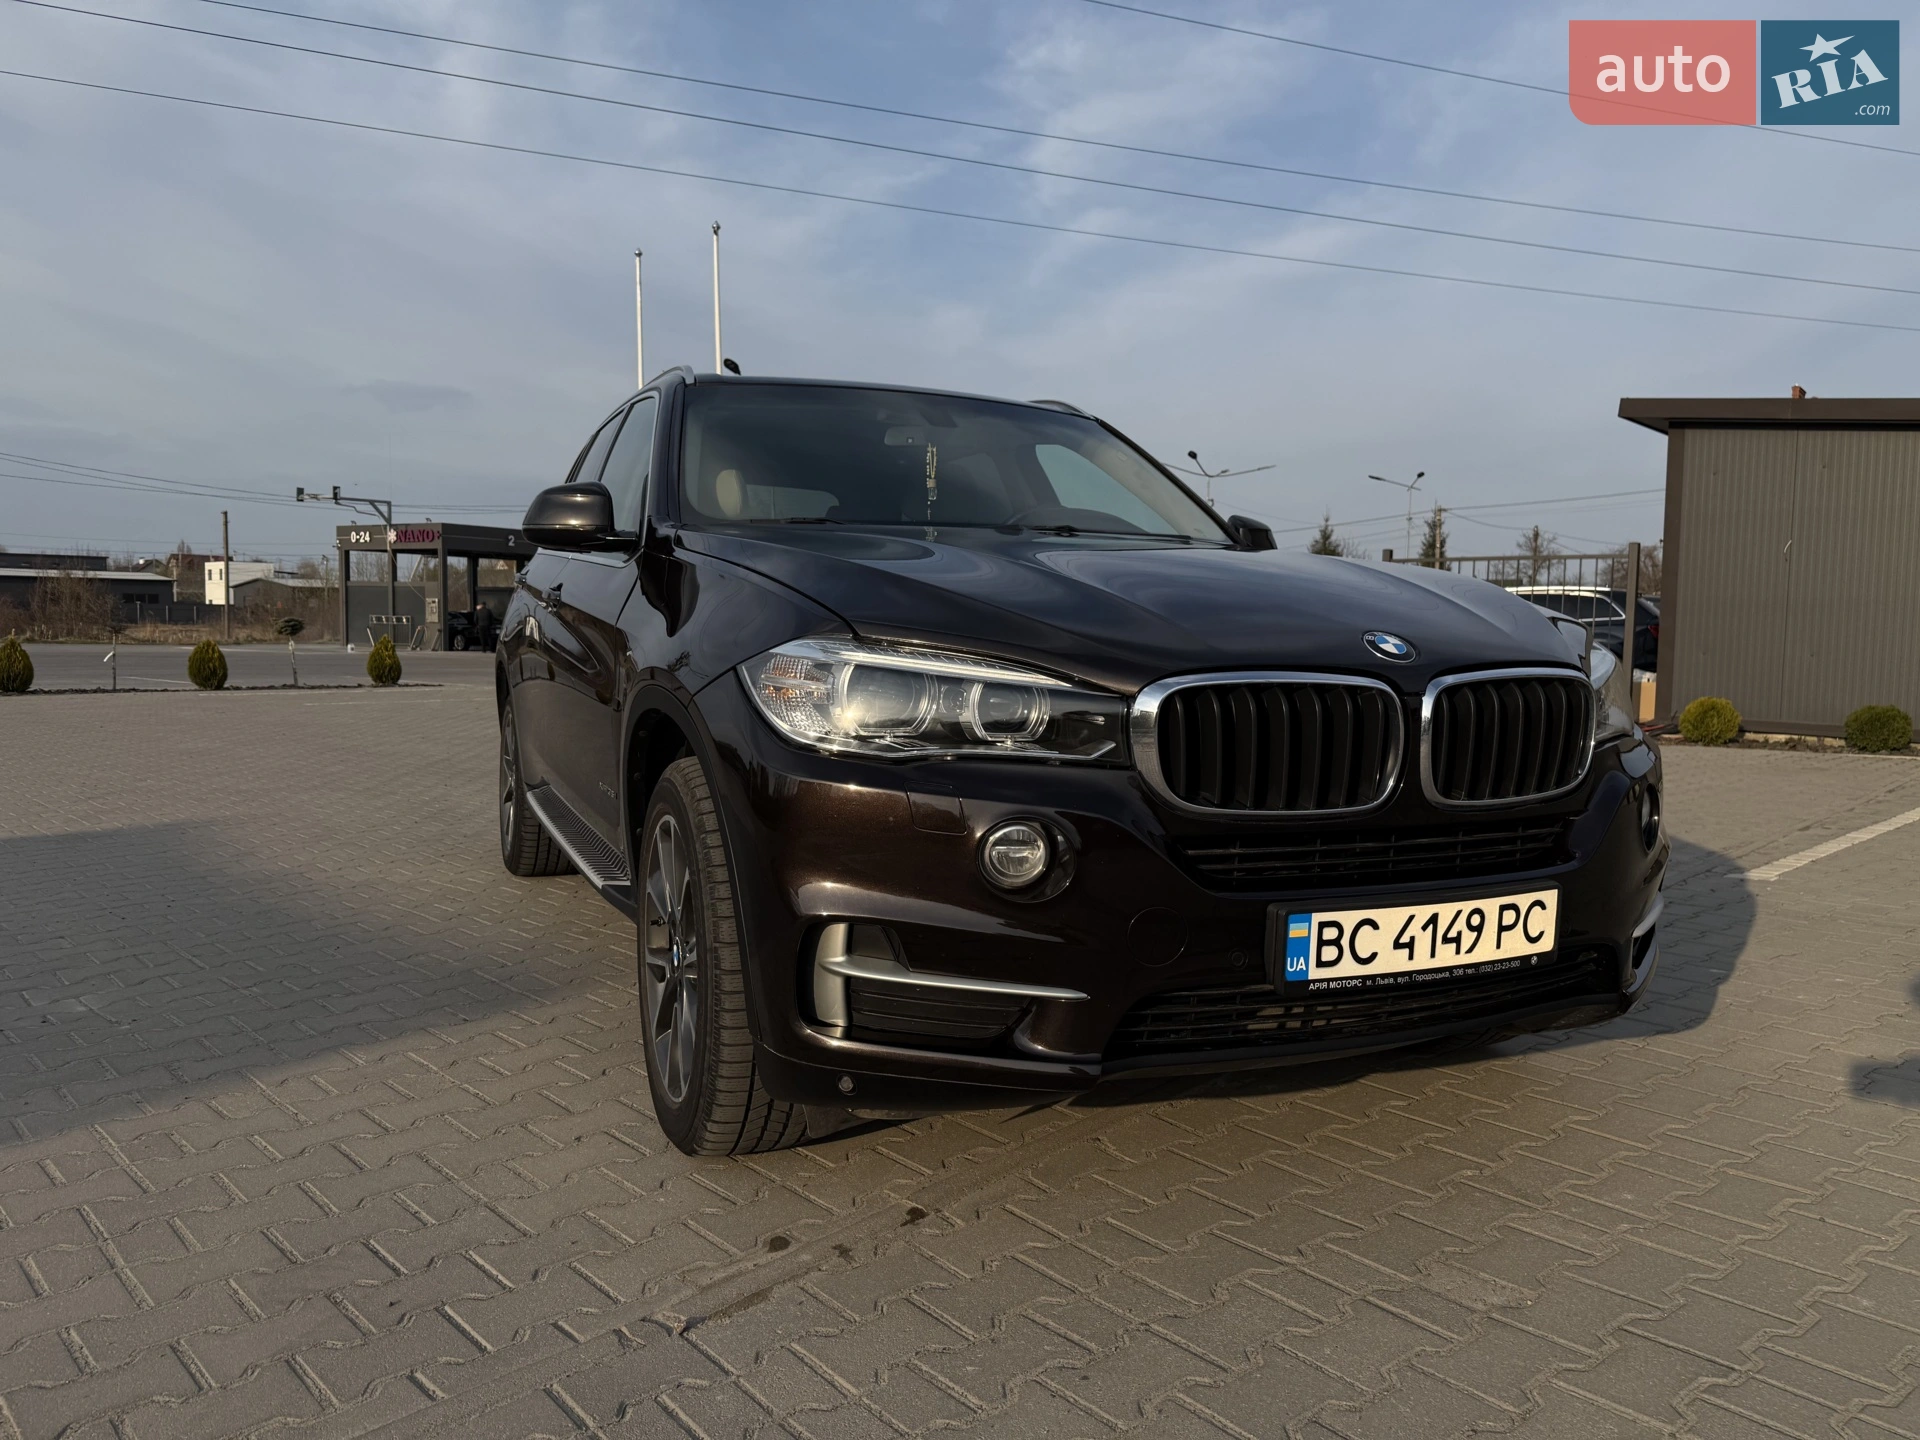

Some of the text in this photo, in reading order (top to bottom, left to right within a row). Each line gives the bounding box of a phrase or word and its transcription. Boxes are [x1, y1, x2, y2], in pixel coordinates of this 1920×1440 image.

[397, 529, 434, 543] NANO
[508, 534, 515, 546] 2
[1315, 899, 1547, 969] BC 4149 PC
[1287, 956, 1307, 973] UA
[1308, 981, 1328, 991] АРІЯ
[1329, 978, 1363, 989] МОТОРС
